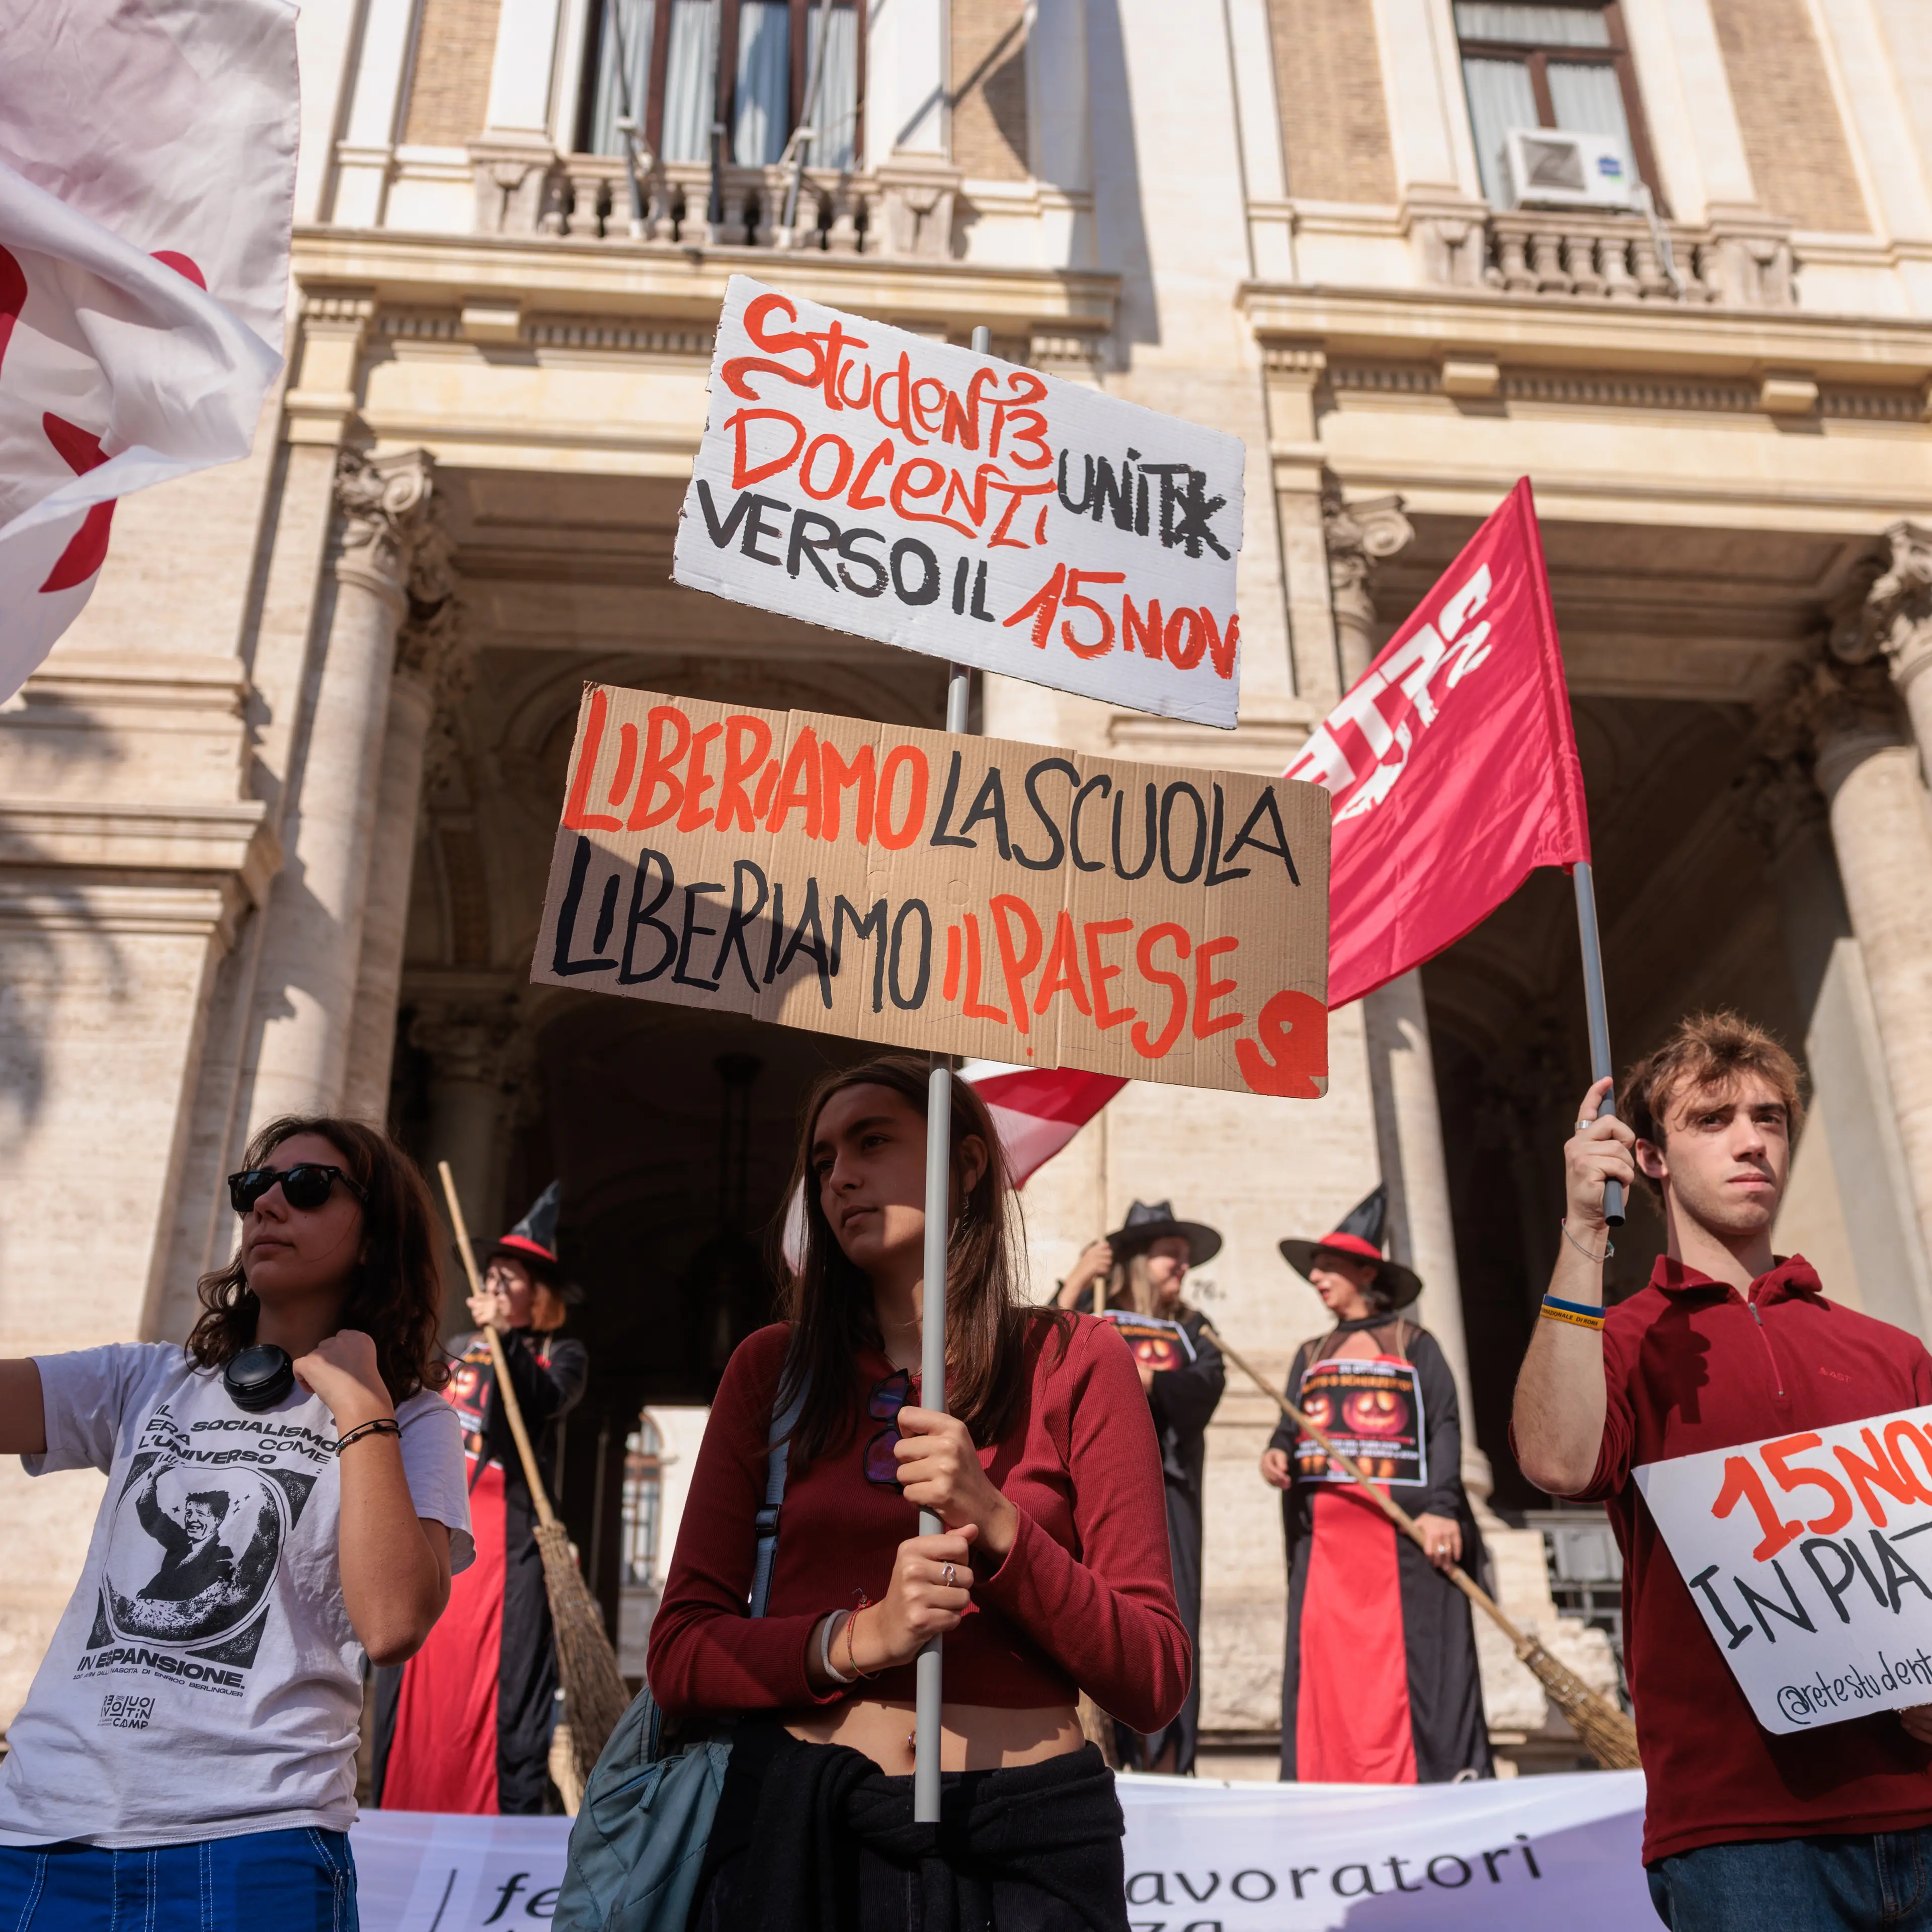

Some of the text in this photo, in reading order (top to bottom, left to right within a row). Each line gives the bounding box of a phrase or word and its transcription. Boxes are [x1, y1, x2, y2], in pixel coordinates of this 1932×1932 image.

[696, 479, 1239, 680] VERSO IL 15 NOV
[562, 689, 1301, 887] LIBERIAMO LA SCUOLA
[553, 835, 1245, 1059] LIBERIAMO IL PAESE
[137, 1434, 277, 1464] L'UNIVERSO
[145, 1419, 332, 1464] ERA COME
[155, 1404, 337, 1453] IL SOCIALISMO
[1711, 1420, 1932, 1563] 15 NO
[1688, 1559, 1819, 1650] IN
[77, 1655, 97, 1671] IN
[154, 1671, 185, 1685] ENRICO
[189, 1681, 244, 1698] BERLINGUER
[113, 1717, 148, 1729] CAMP
